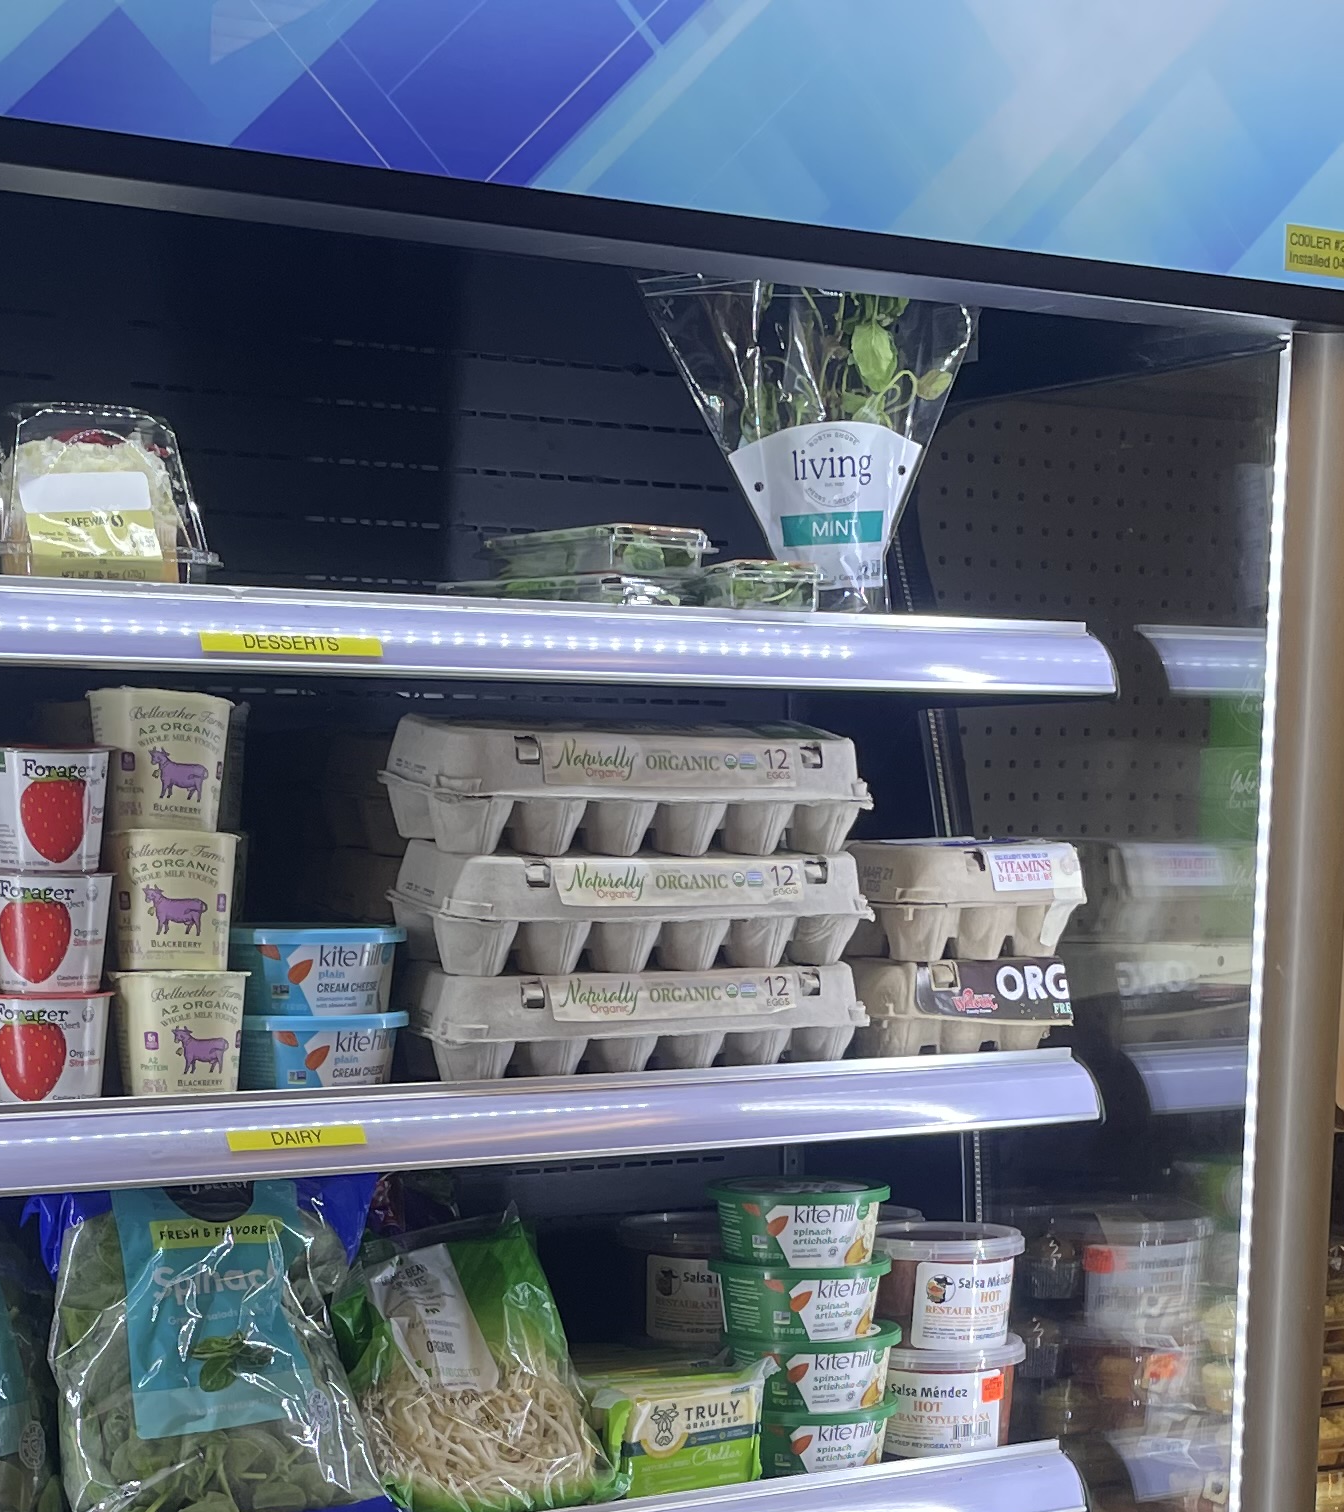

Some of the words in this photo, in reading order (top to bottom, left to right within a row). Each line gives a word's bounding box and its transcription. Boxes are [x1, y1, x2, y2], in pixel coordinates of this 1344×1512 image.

[1290, 232, 1332, 250] COOLER
[1289, 250, 1331, 268] Installed
[792, 448, 872, 486] living
[812, 520, 858, 537] MINT
[243, 634, 340, 652] DESSERTS
[130, 705, 197, 722] Bellwether
[161, 722, 221, 743] ORGANIC
[552, 738, 638, 781] Naturally
[645, 755, 720, 772] ORGANIC
[764, 748, 790, 769] 12
[766, 771, 791, 780] EGGS
[153, 803, 202, 815] BLACKBERRY
[152, 859, 219, 877] ORGANIC
[770, 865, 797, 886] 12
[995, 860, 1052, 875] VITAMINS
[565, 862, 646, 901] Naturally
[0, 880, 75, 901] Forager
[772, 887, 799, 897] EGGS
[151, 940, 203, 949] BLACKBERRY
[319, 945, 358, 968] kite
[318, 970, 346, 981] plain
[351, 981, 378, 993] CHEESE
[764, 975, 790, 997] 12
[559, 977, 640, 1016] Naturally
[766, 998, 790, 1007] EGGS
[335, 1031, 371, 1053] kite
[270, 1129, 323, 1146] DAIRY
[794, 1206, 831, 1224] kite
[159, 1228, 200, 1240] FRESH
[793, 1227, 832, 1238] spinach
[958, 1276, 985, 1289] Salsa
[980, 1290, 1002, 1304] HOT
[891, 1382, 917, 1397] Salsa
[920, 1385, 968, 1399] Méndez
[684, 1399, 741, 1422] TRULY
[913, 1400, 944, 1413] HOT
[927, 1414, 959, 1425] STYLE
[961, 1412, 991, 1424] SALSA
[692, 1446, 743, 1467] Cheddar
